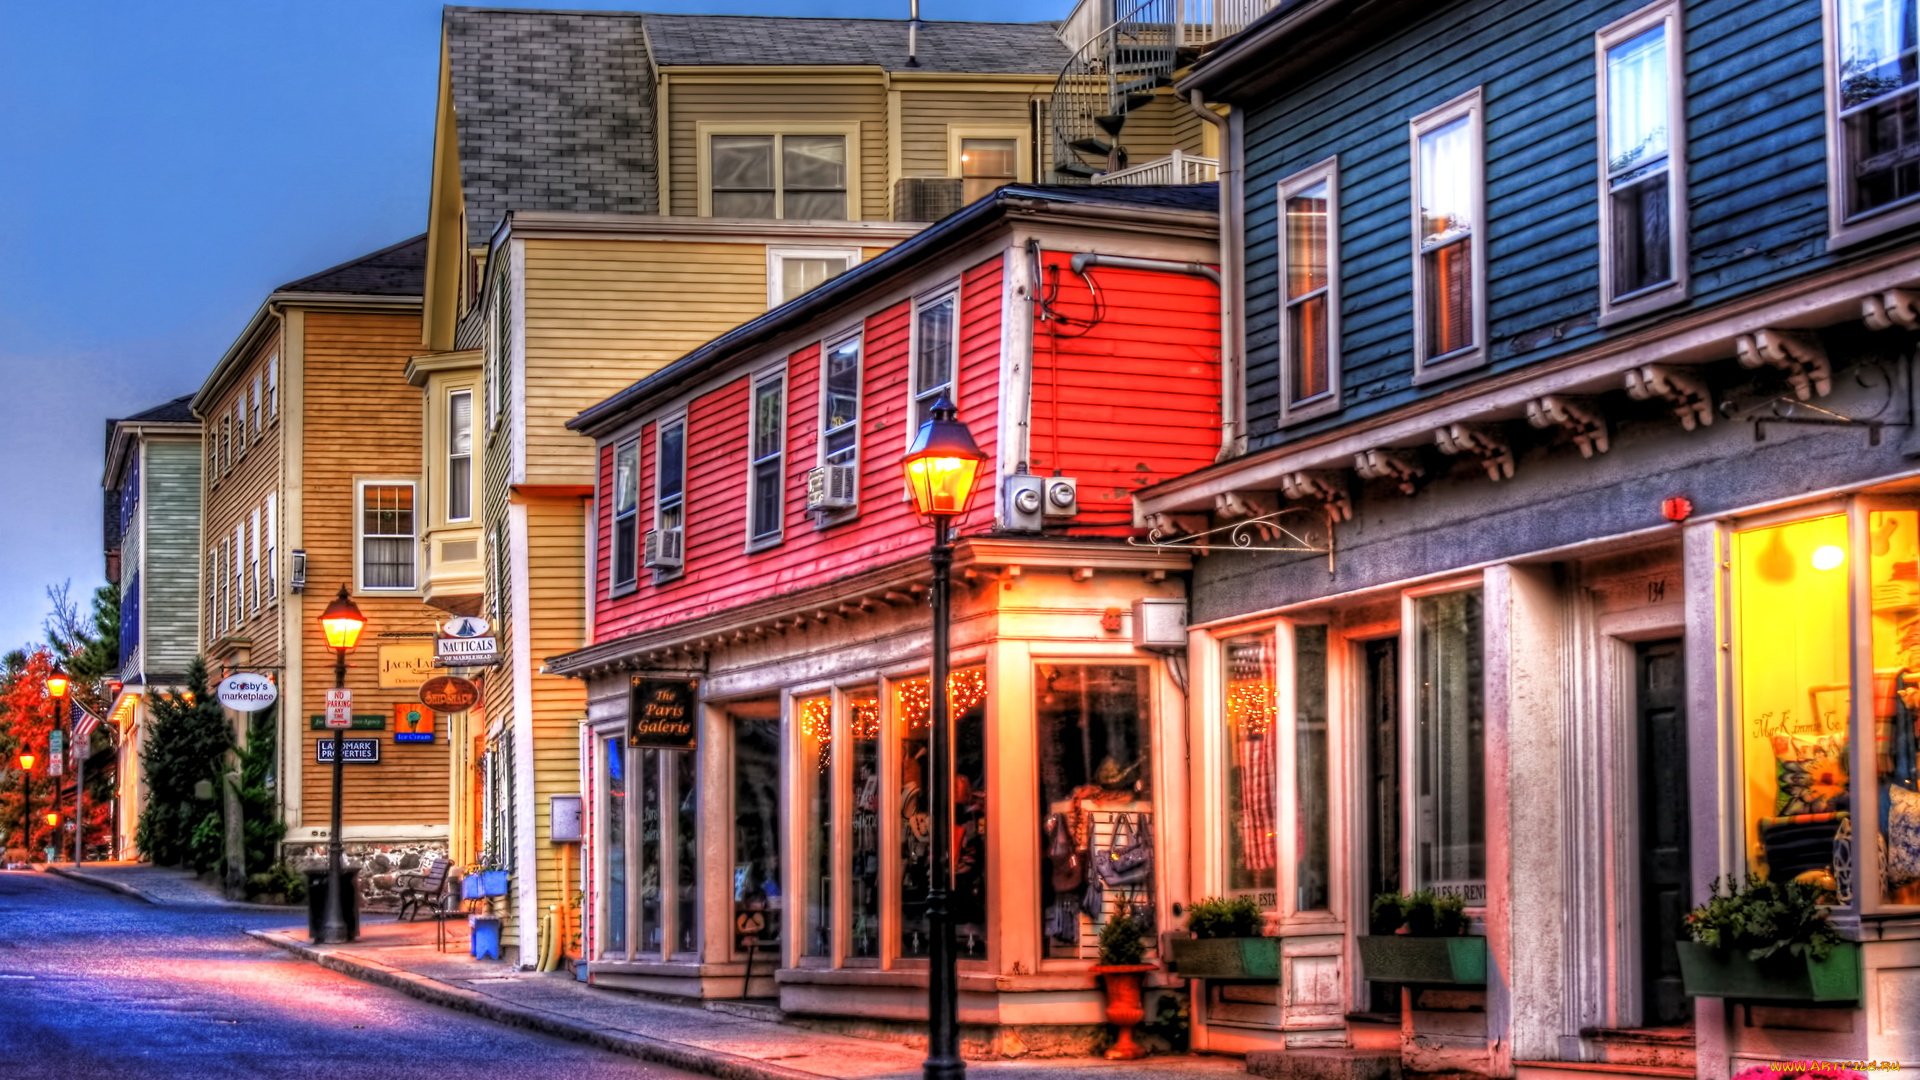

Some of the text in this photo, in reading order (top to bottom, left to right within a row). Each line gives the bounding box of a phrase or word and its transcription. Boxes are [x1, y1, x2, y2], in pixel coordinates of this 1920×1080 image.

[443, 640, 493, 652] NAUTICALS
[221, 692, 274, 702] marketplace
[334, 691, 344, 699] NO
[656, 690, 675, 701] The
[327, 700, 351, 708] PARKING
[645, 703, 685, 717] Paris
[638, 719, 691, 735] Galerie
[321, 742, 371, 750] LAMARK
[321, 750, 372, 758] PRERTIES
[1258, 892, 1277, 906] ESTA
